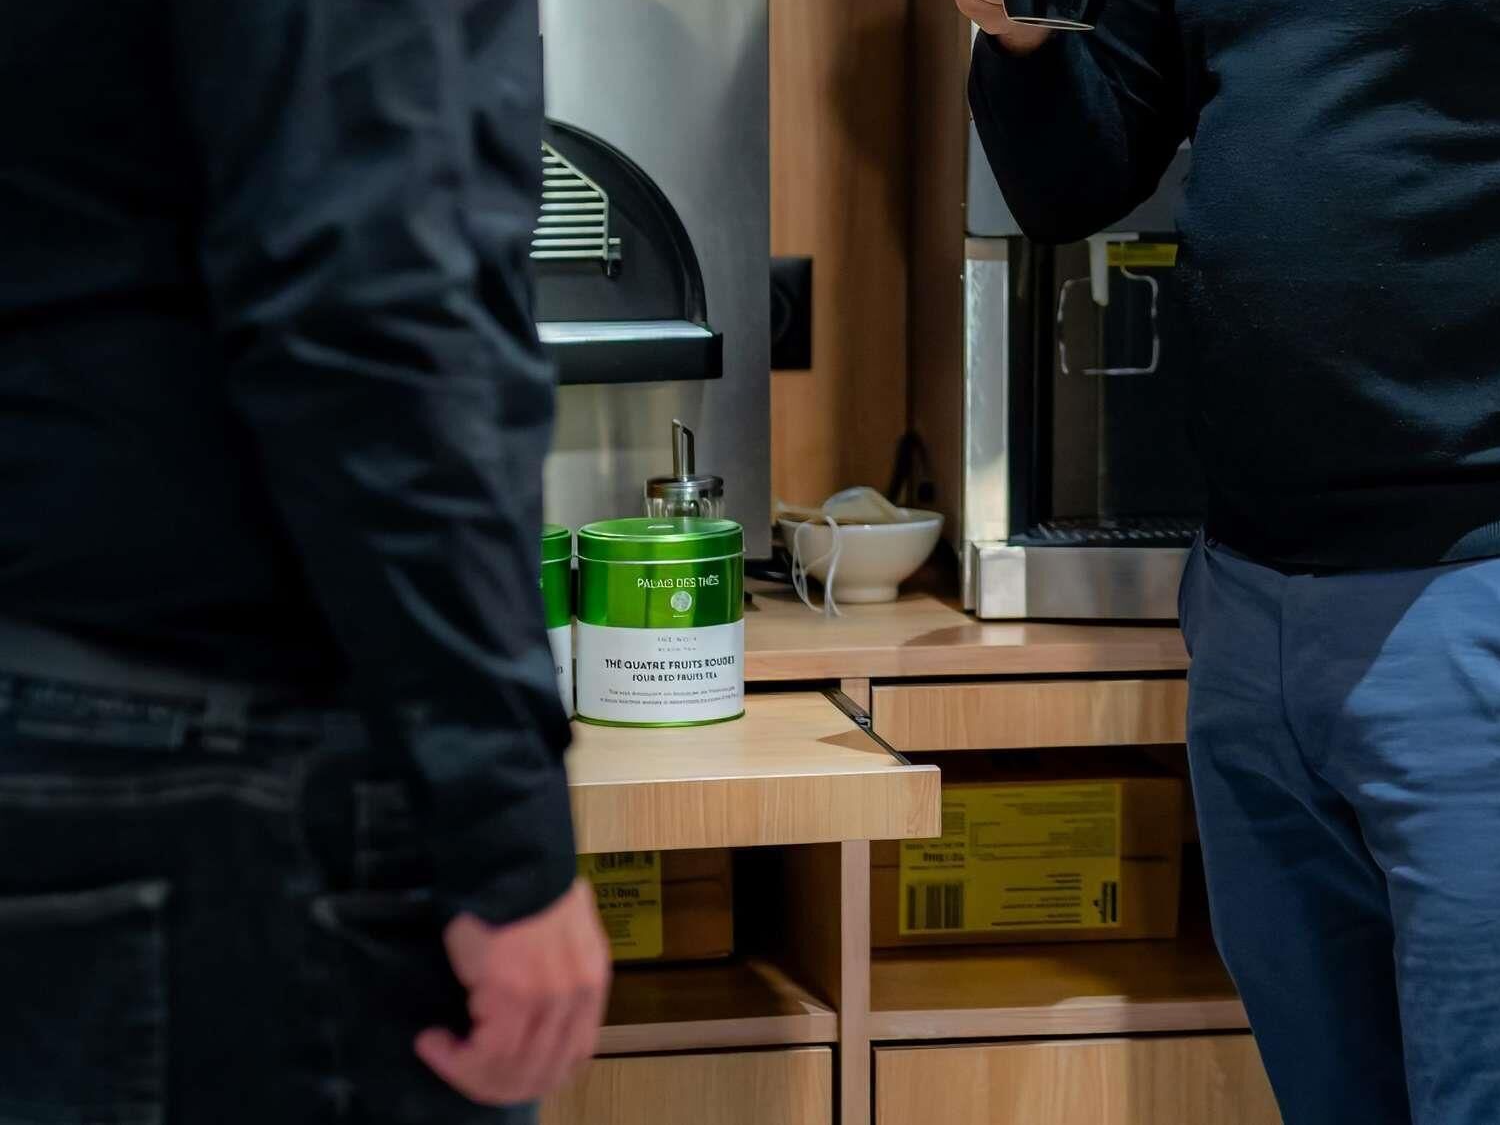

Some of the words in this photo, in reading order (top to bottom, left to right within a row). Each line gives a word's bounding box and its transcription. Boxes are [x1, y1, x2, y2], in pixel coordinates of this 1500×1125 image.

[676, 577, 696, 588] DES
[624, 660, 665, 670] QUATRE
[669, 659, 702, 670] FRUITS
[632, 674, 655, 683] FOUR
